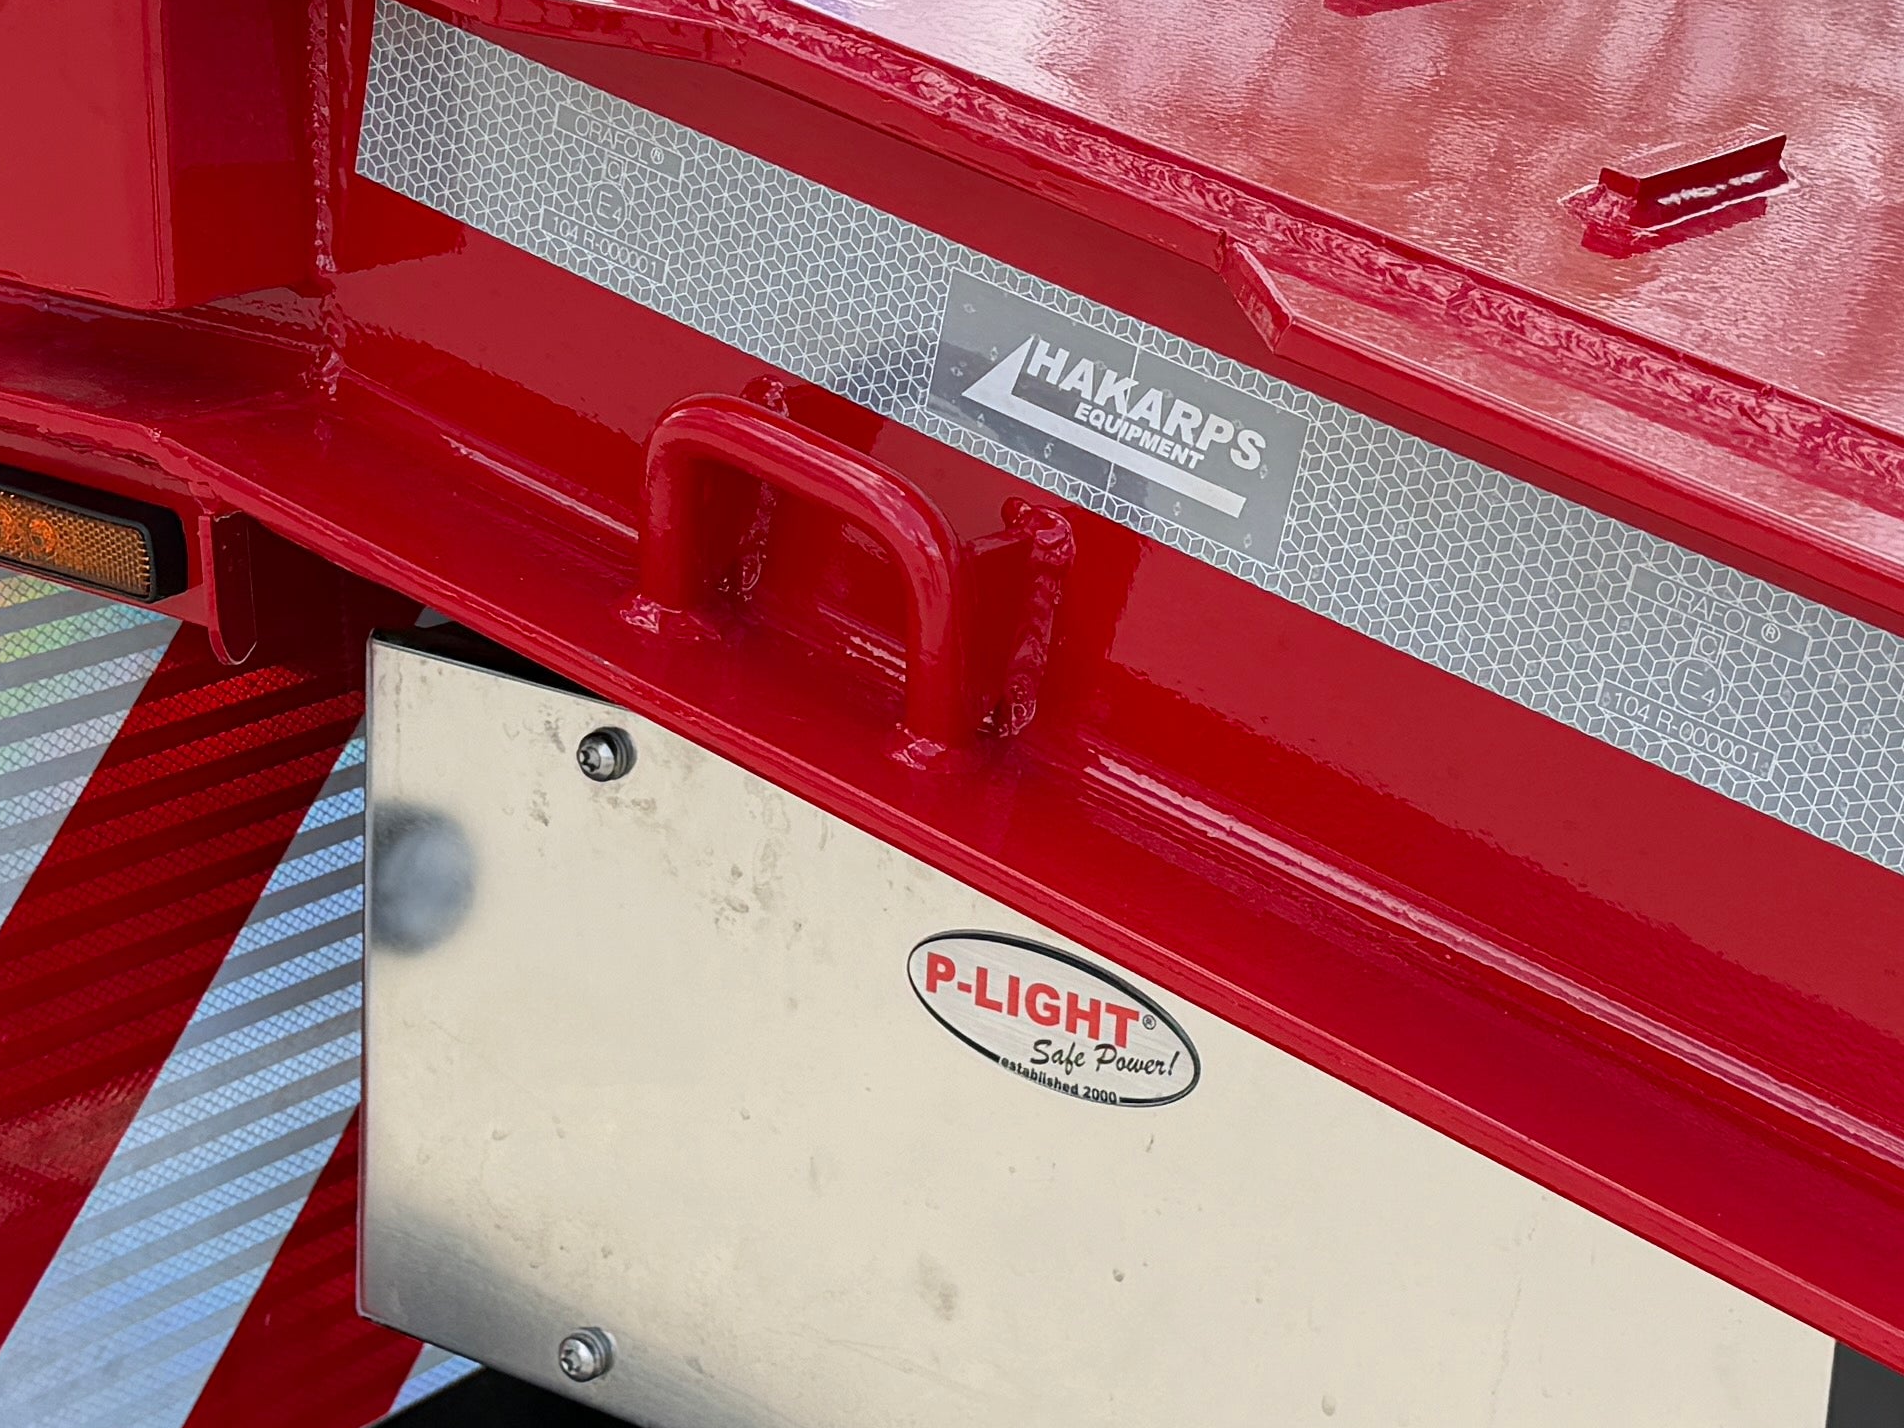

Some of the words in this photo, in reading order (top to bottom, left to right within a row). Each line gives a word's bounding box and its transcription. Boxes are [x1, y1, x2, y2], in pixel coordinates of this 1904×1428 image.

[1026, 339, 1267, 471] HAKARPS
[1074, 402, 1203, 469] EQUIPMENT
[1001, 1057, 1079, 1095] established
[1082, 1085, 1117, 1103] 2000
[1030, 1039, 1086, 1075] Safe
[1093, 1043, 1180, 1076] Power!
